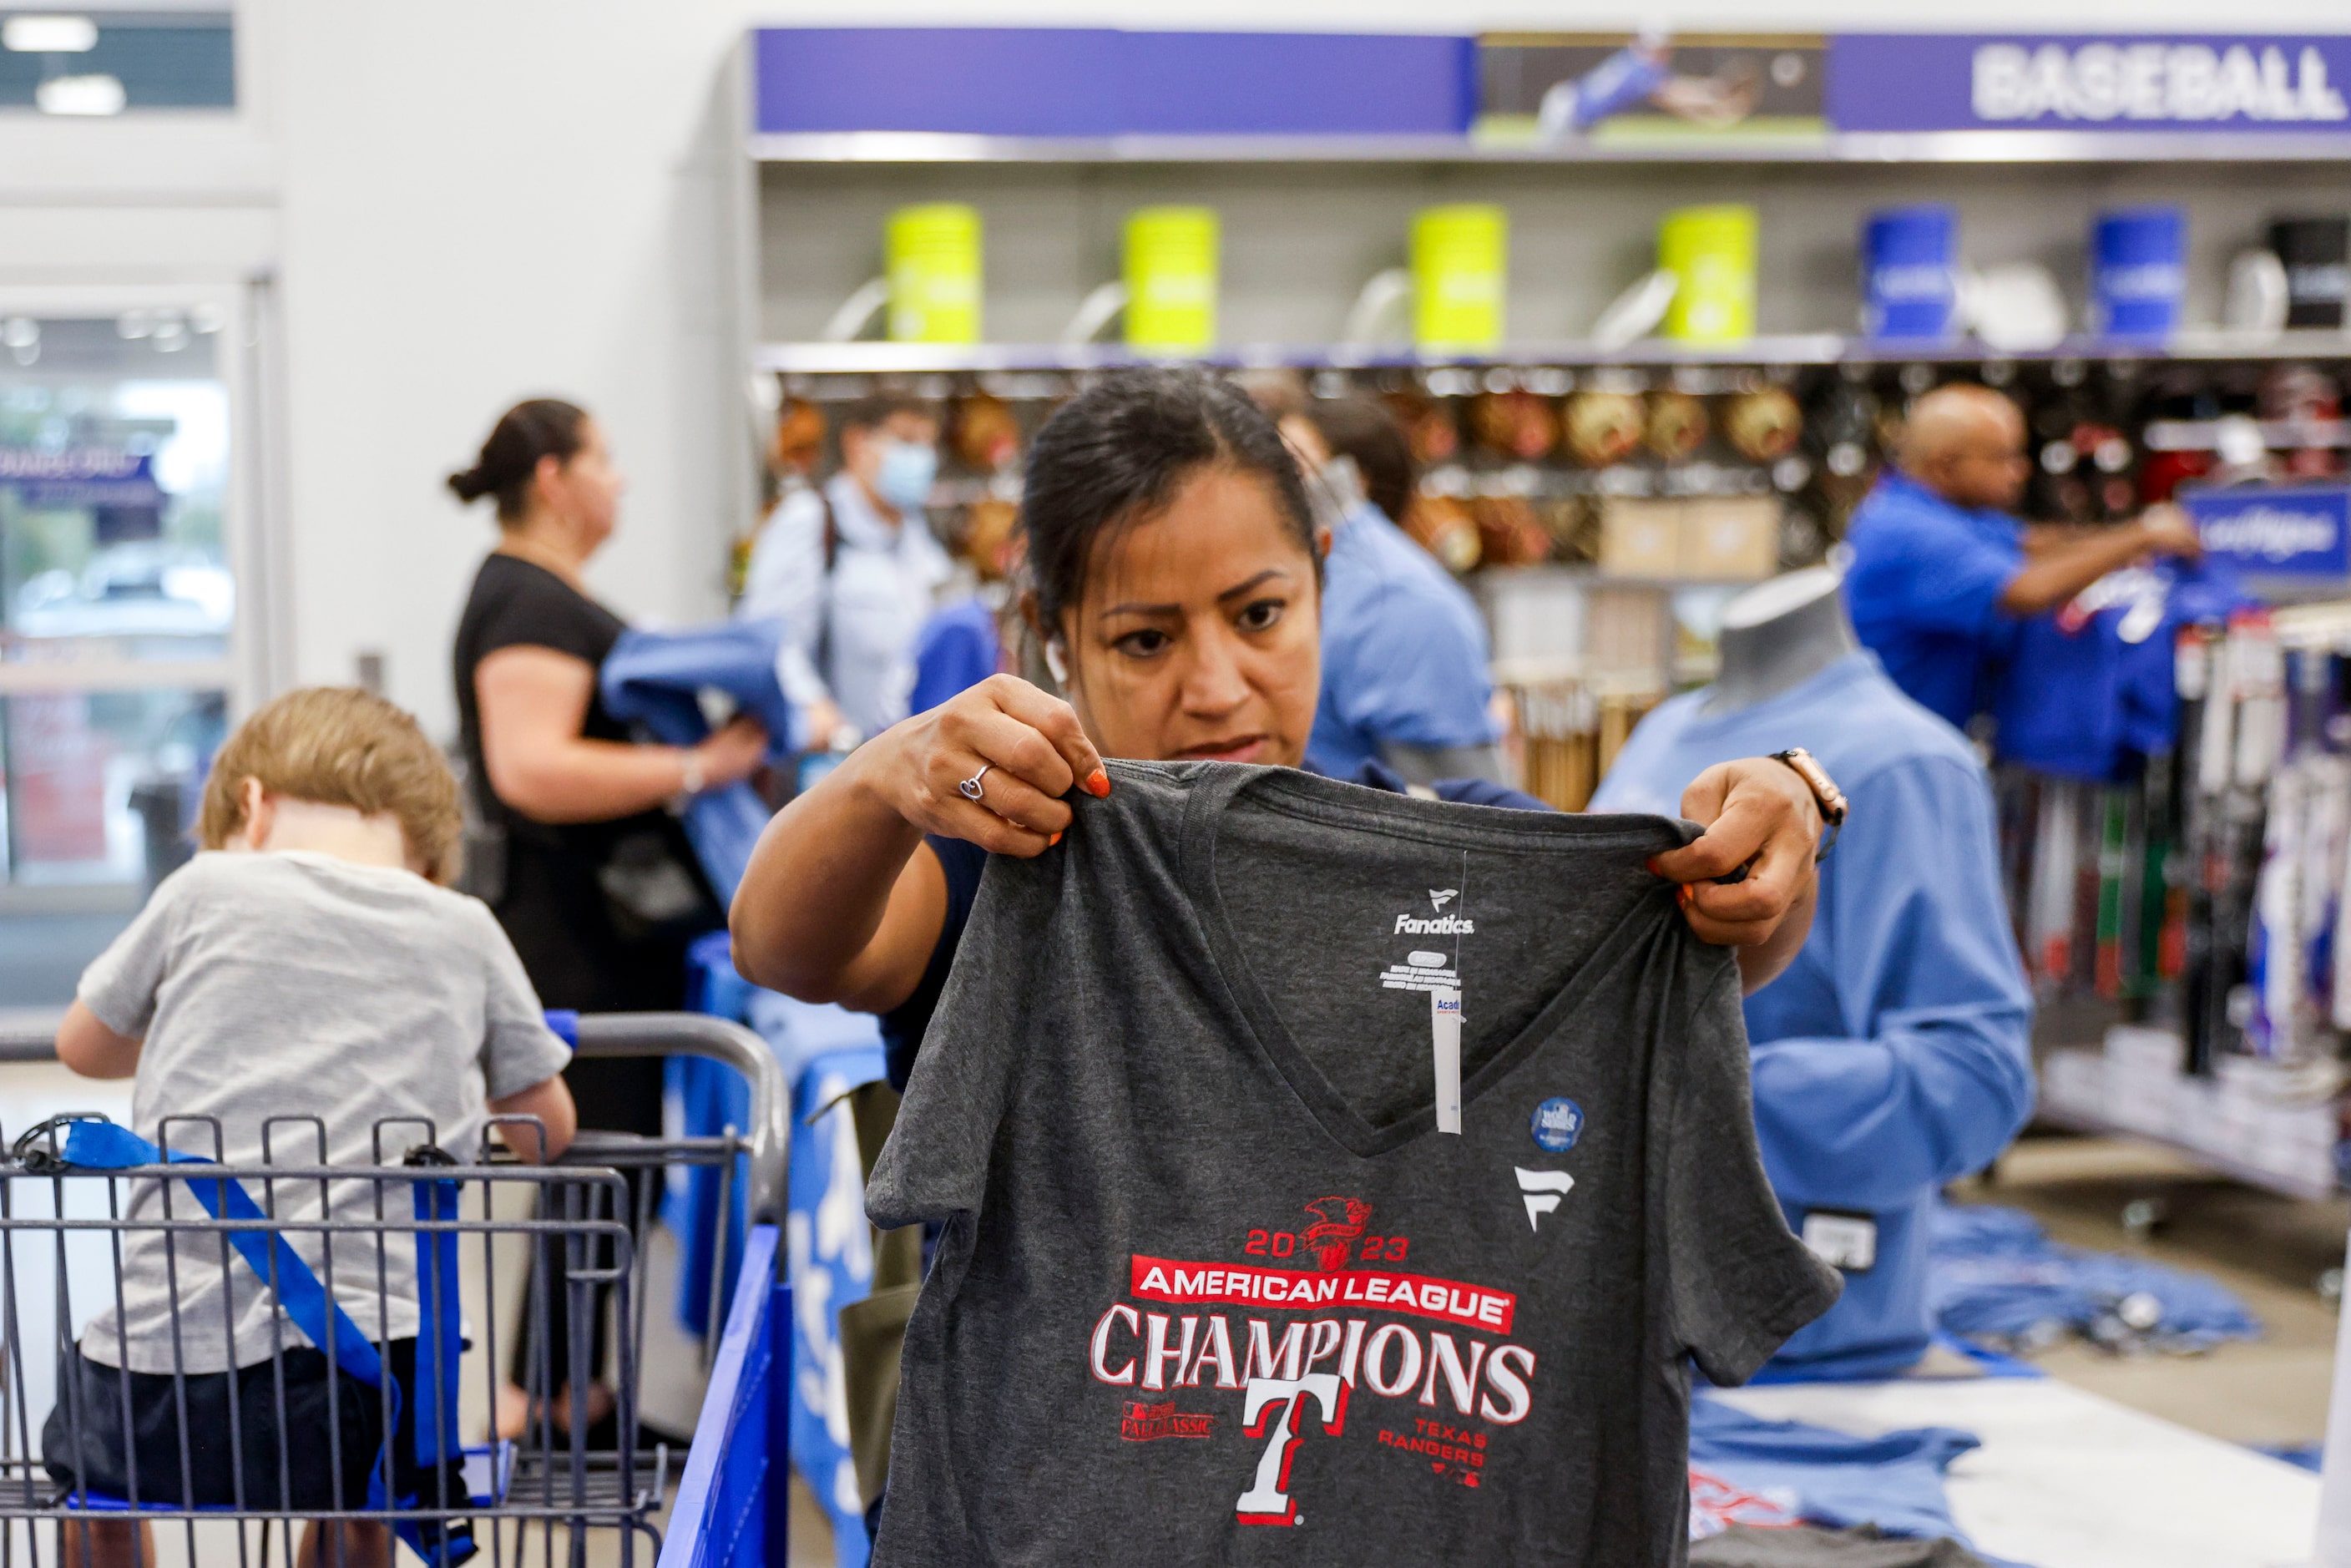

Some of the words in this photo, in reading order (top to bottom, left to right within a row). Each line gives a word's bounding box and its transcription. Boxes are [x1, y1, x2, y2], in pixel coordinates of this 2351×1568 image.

[1972, 43, 2348, 120] BASEBALL
[1245, 1229, 1295, 1258] 20
[1360, 1237, 1409, 1262] 23
[1140, 1266, 1337, 1303] AMERICAN
[1343, 1277, 1505, 1325] LEAGUE
[1090, 1302, 1537, 1424] CHAMPIONS
[1236, 1373, 1351, 1527] T
[1378, 1429, 1484, 1468] RANGERS
[1415, 1418, 1487, 1449] TEXAS
